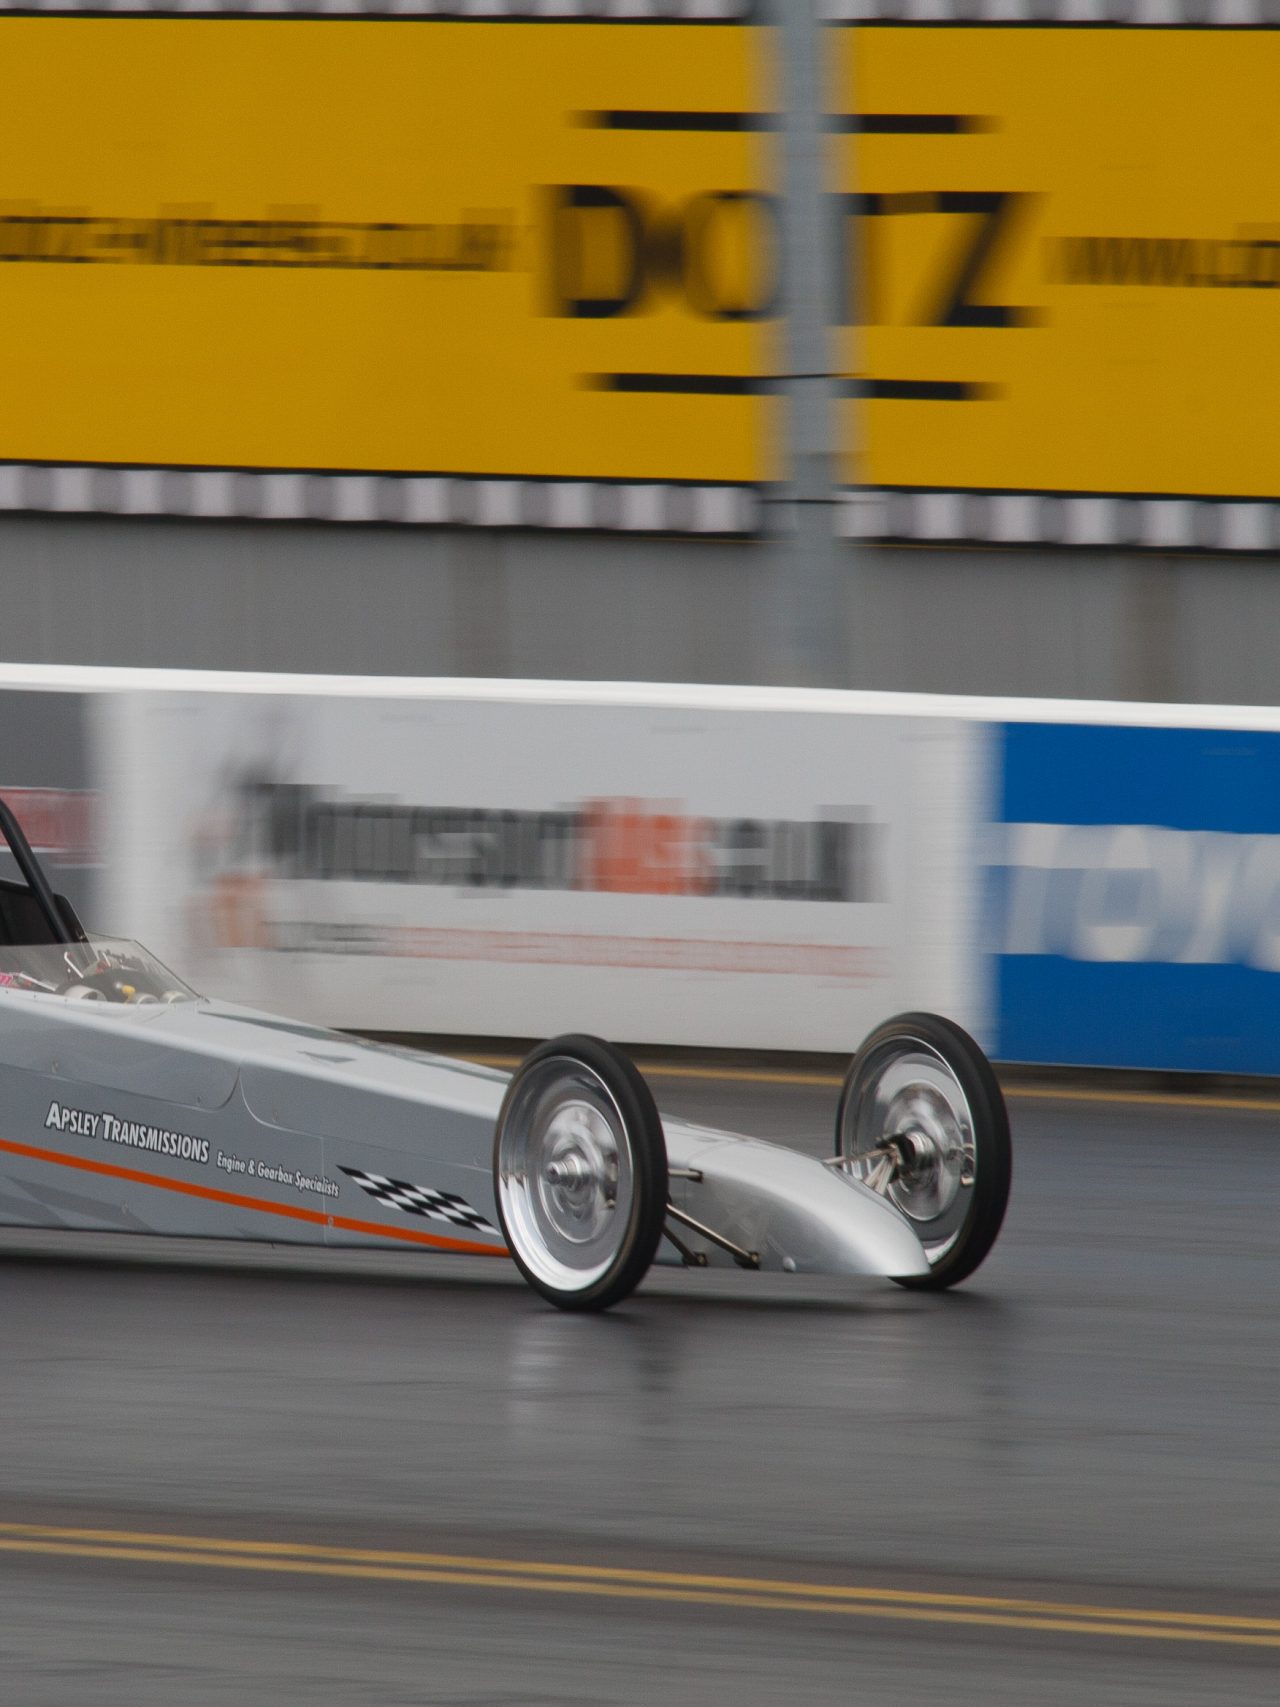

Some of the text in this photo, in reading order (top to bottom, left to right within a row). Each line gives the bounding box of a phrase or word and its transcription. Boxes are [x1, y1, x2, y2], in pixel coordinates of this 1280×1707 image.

[44, 1101, 210, 1163] APSLEY TRANSMISSIONS
[216, 1150, 340, 1199] Engine & Gearbox Specialists
